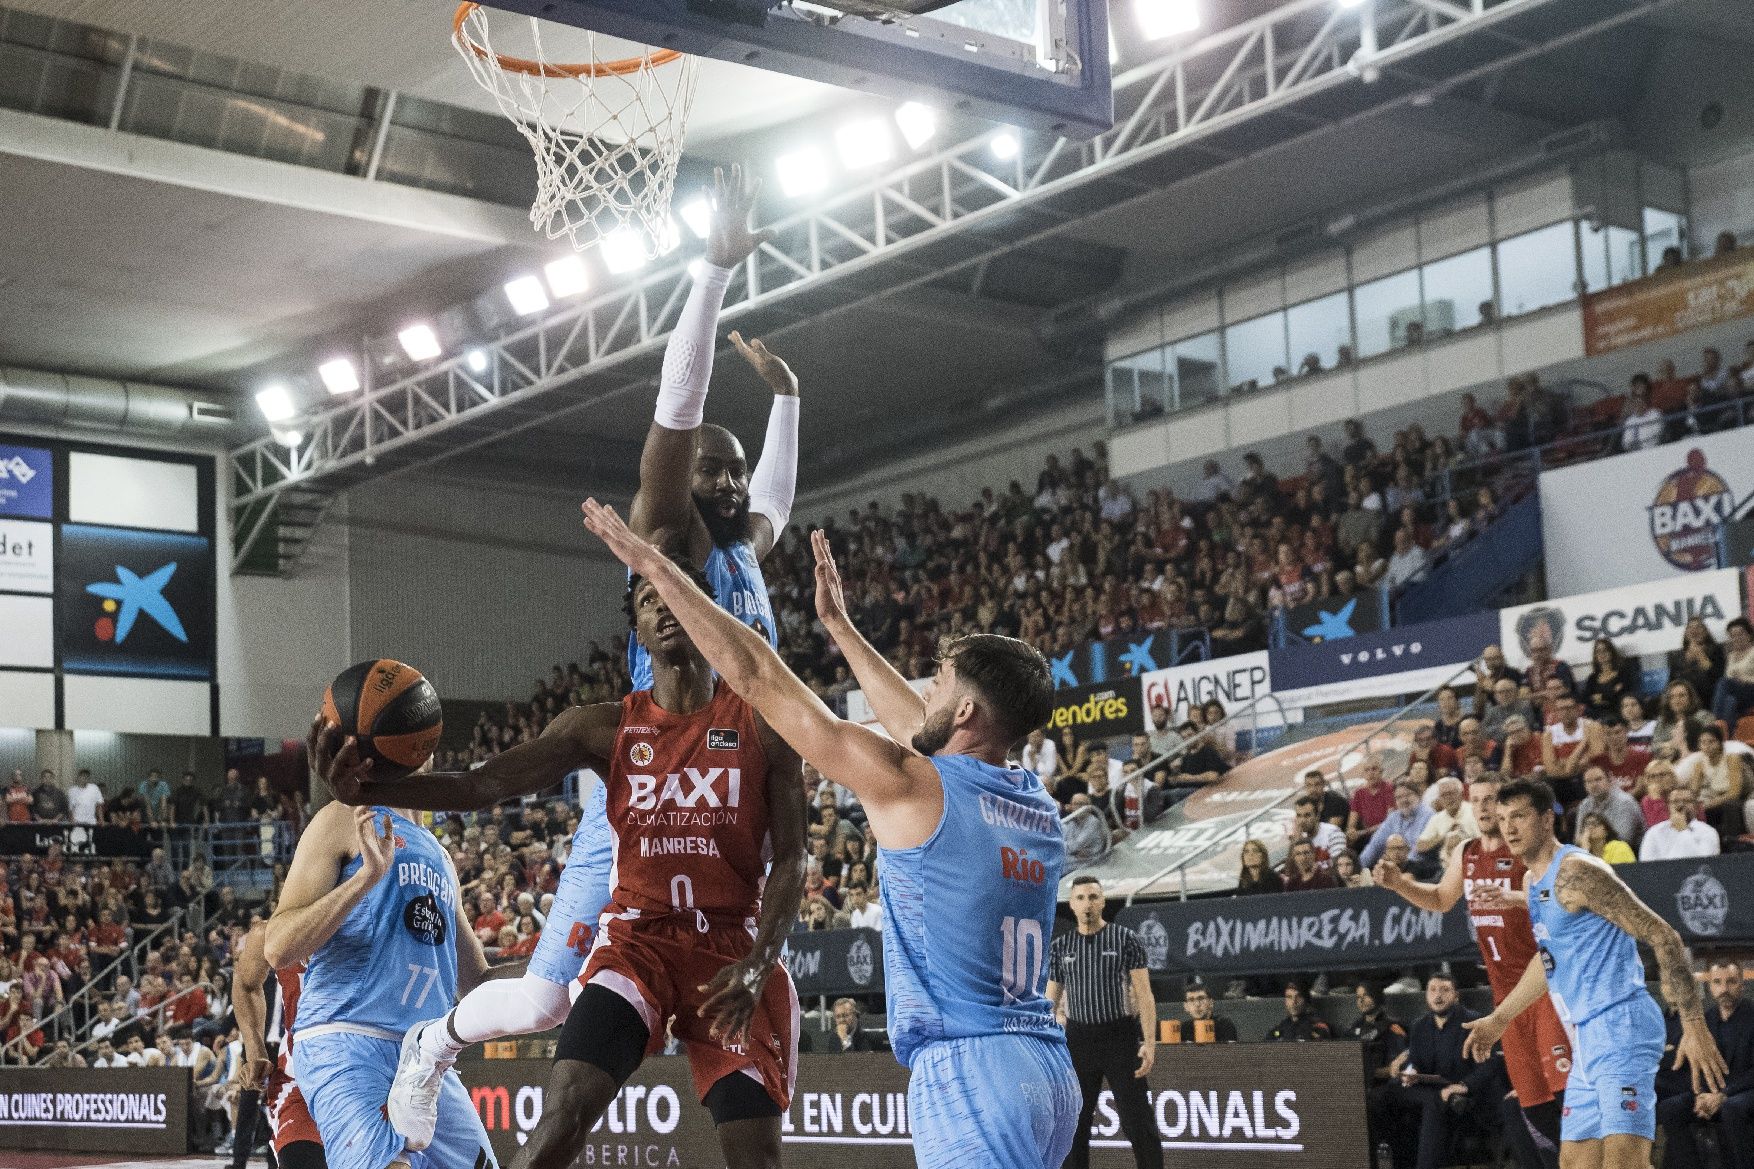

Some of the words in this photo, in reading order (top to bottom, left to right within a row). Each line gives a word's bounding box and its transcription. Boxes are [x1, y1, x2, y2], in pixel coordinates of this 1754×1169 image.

[1576, 593, 1724, 642] SCANIA
[1340, 641, 1423, 665] VOLVO
[1175, 666, 1266, 714] AIGNEP
[626, 767, 741, 811] BAXI
[640, 836, 721, 858] MANRESA
[1001, 915, 1043, 1006] 10
[1486, 936, 1502, 962] 1
[400, 963, 438, 1009] 77
[11, 1093, 54, 1120] CUINES
[56, 1093, 166, 1123] PROFESSIONALS
[803, 1092, 843, 1133] EN
[852, 1092, 912, 1135] CUI
[576, 1144, 680, 1167] BERICA
